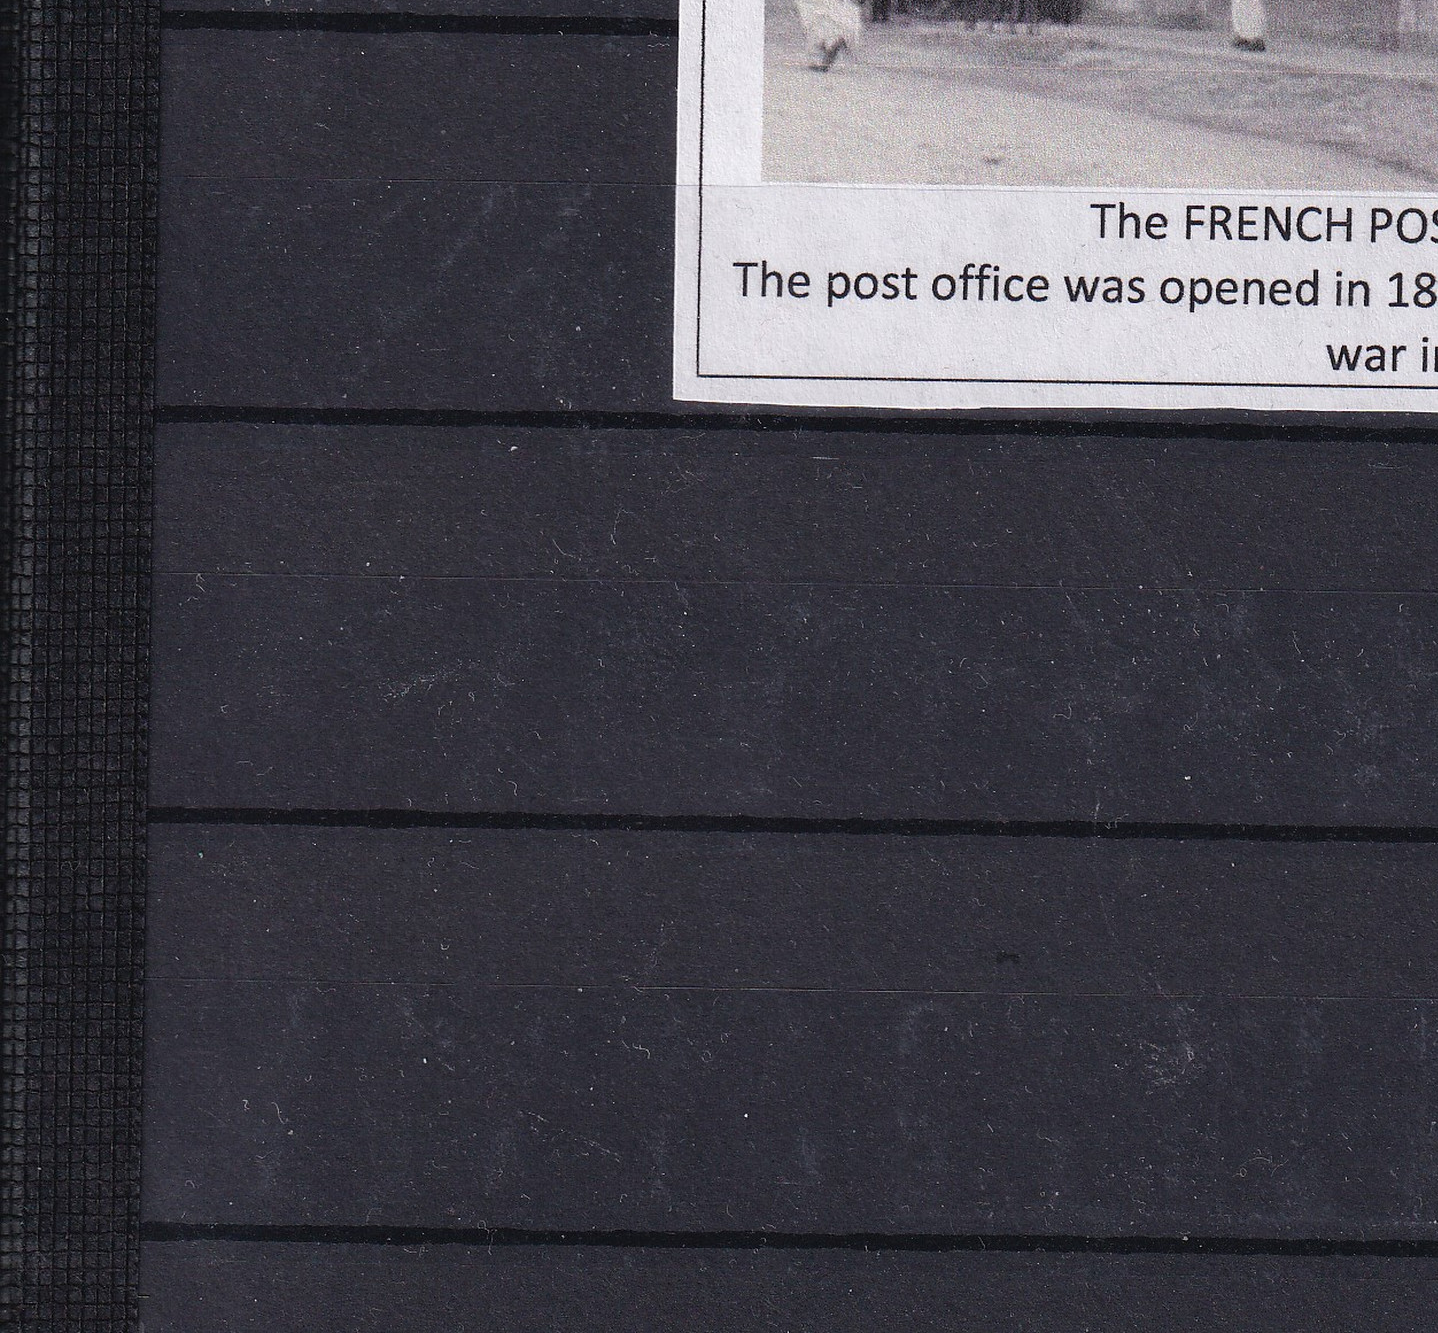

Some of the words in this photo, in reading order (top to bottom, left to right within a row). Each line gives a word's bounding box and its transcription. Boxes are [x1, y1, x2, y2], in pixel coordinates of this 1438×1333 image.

[1089, 201, 1169, 241] The
[1185, 204, 1353, 243] FRENCH
[732, 259, 811, 299] The
[827, 267, 919, 308] post
[931, 262, 1050, 303] office
[1063, 275, 1146, 304] was
[1159, 268, 1319, 313] opened
[1335, 270, 1371, 308] in
[1325, 344, 1407, 373] war
